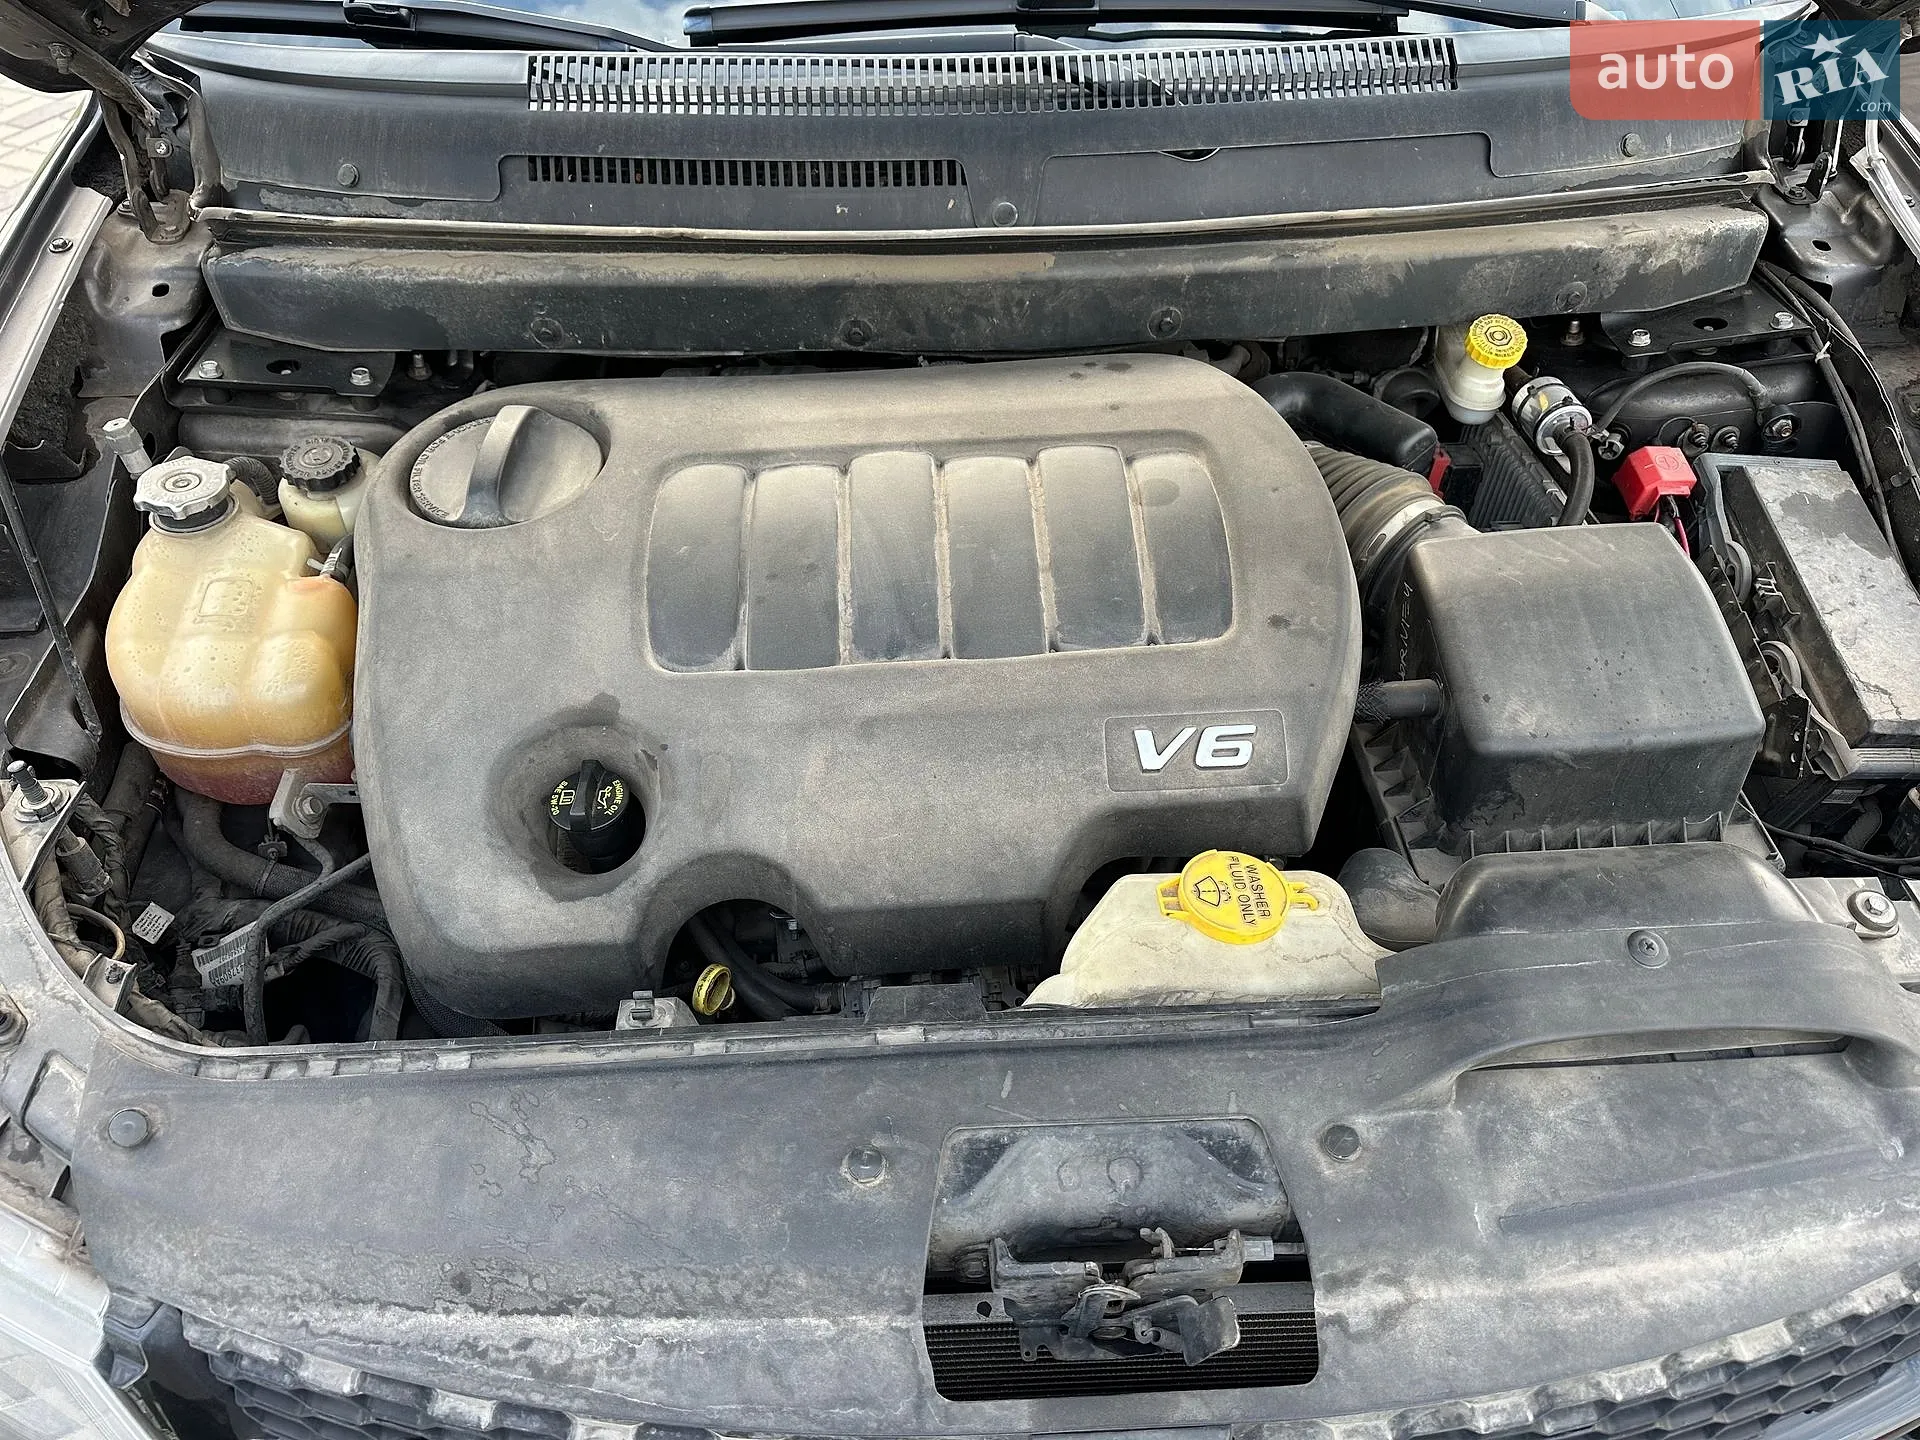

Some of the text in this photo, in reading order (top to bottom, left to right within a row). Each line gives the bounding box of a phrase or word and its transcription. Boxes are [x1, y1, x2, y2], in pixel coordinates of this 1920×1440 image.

[415, 453, 430, 467] OIL
[424, 437, 446, 454] FOR
[411, 467, 423, 493] FILTER
[415, 492, 450, 519] SERVICE
[1132, 724, 1258, 774] V6
[550, 780, 569, 816] SAE 5W-20
[603, 779, 624, 816] ENGINE OIL
[1228, 856, 1257, 926] FLUID ONLY
[1245, 864, 1271, 918] WASHER
